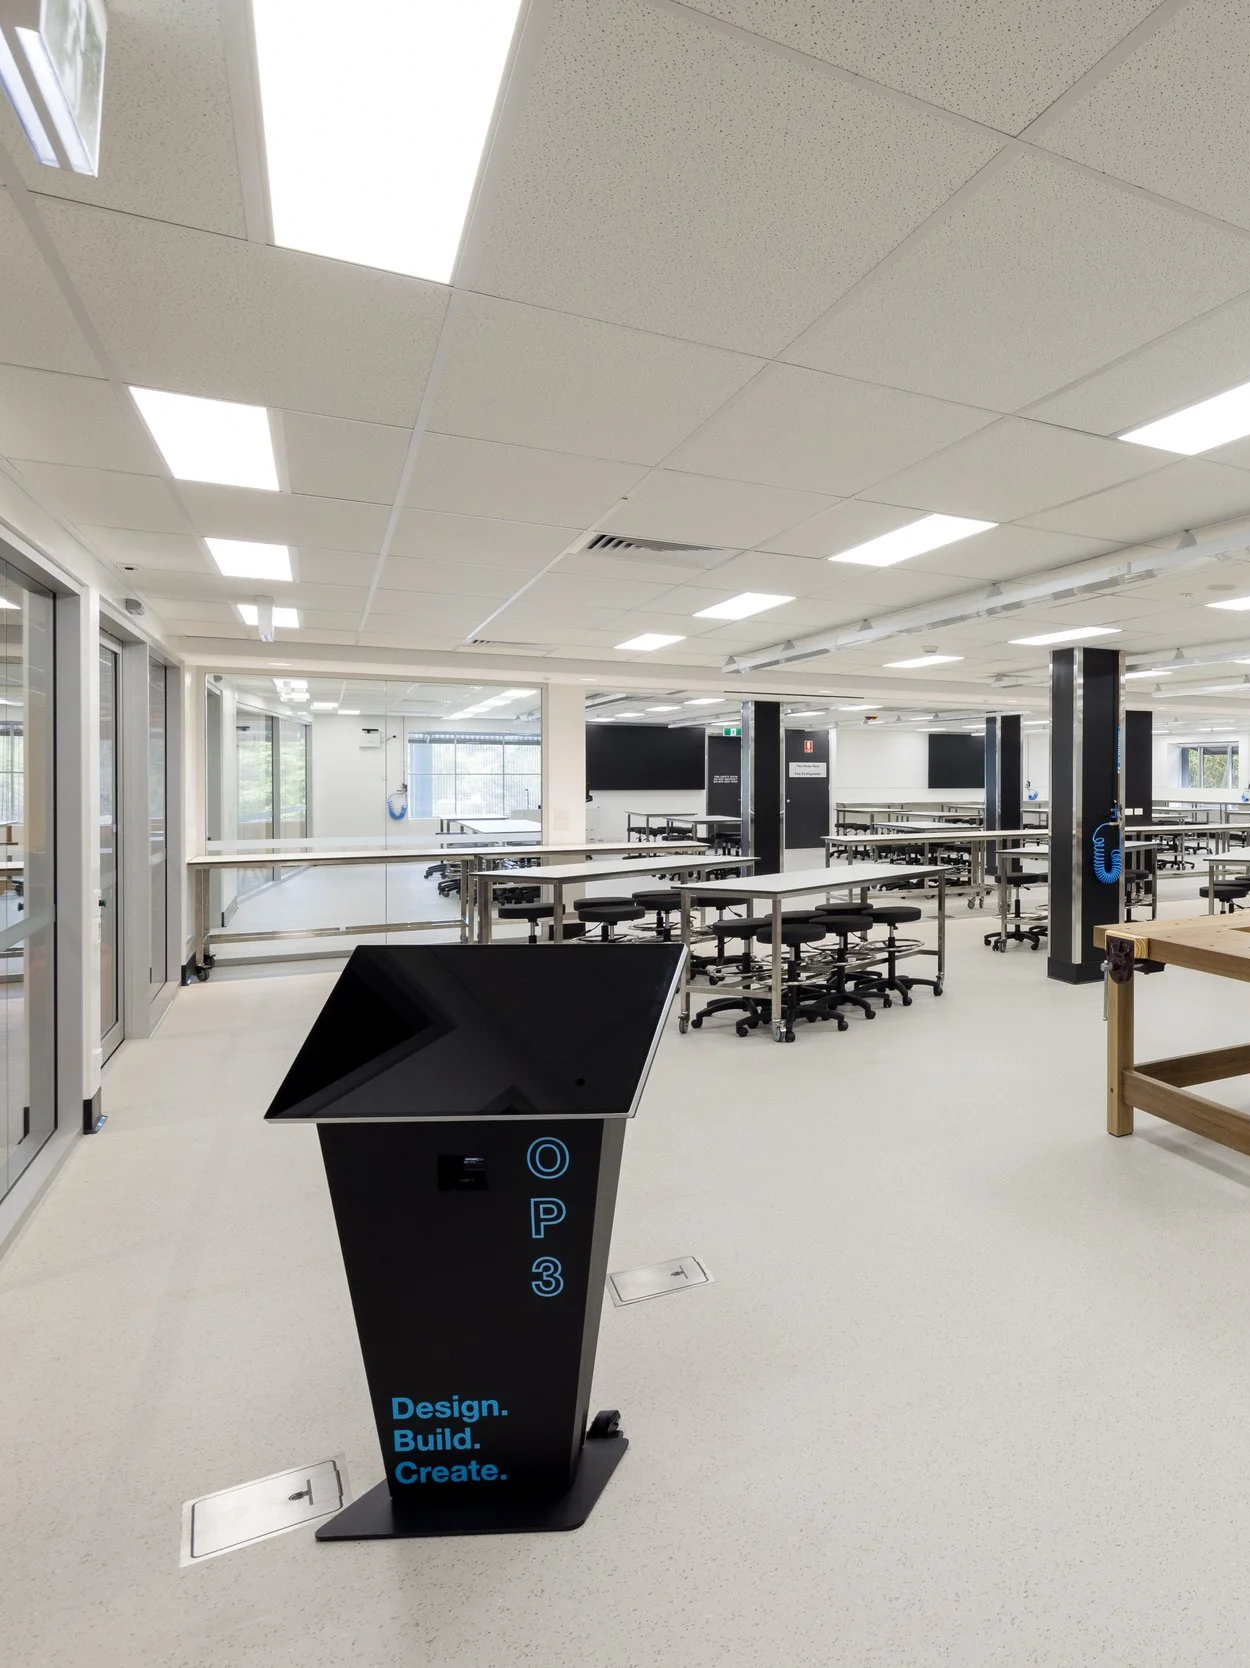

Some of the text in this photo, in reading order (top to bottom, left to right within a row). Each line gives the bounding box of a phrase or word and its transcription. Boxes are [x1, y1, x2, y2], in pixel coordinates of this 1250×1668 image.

[391, 1395, 509, 1423] Design.
[393, 1426, 480, 1453] Build.
[395, 1460, 507, 1484] Create.
